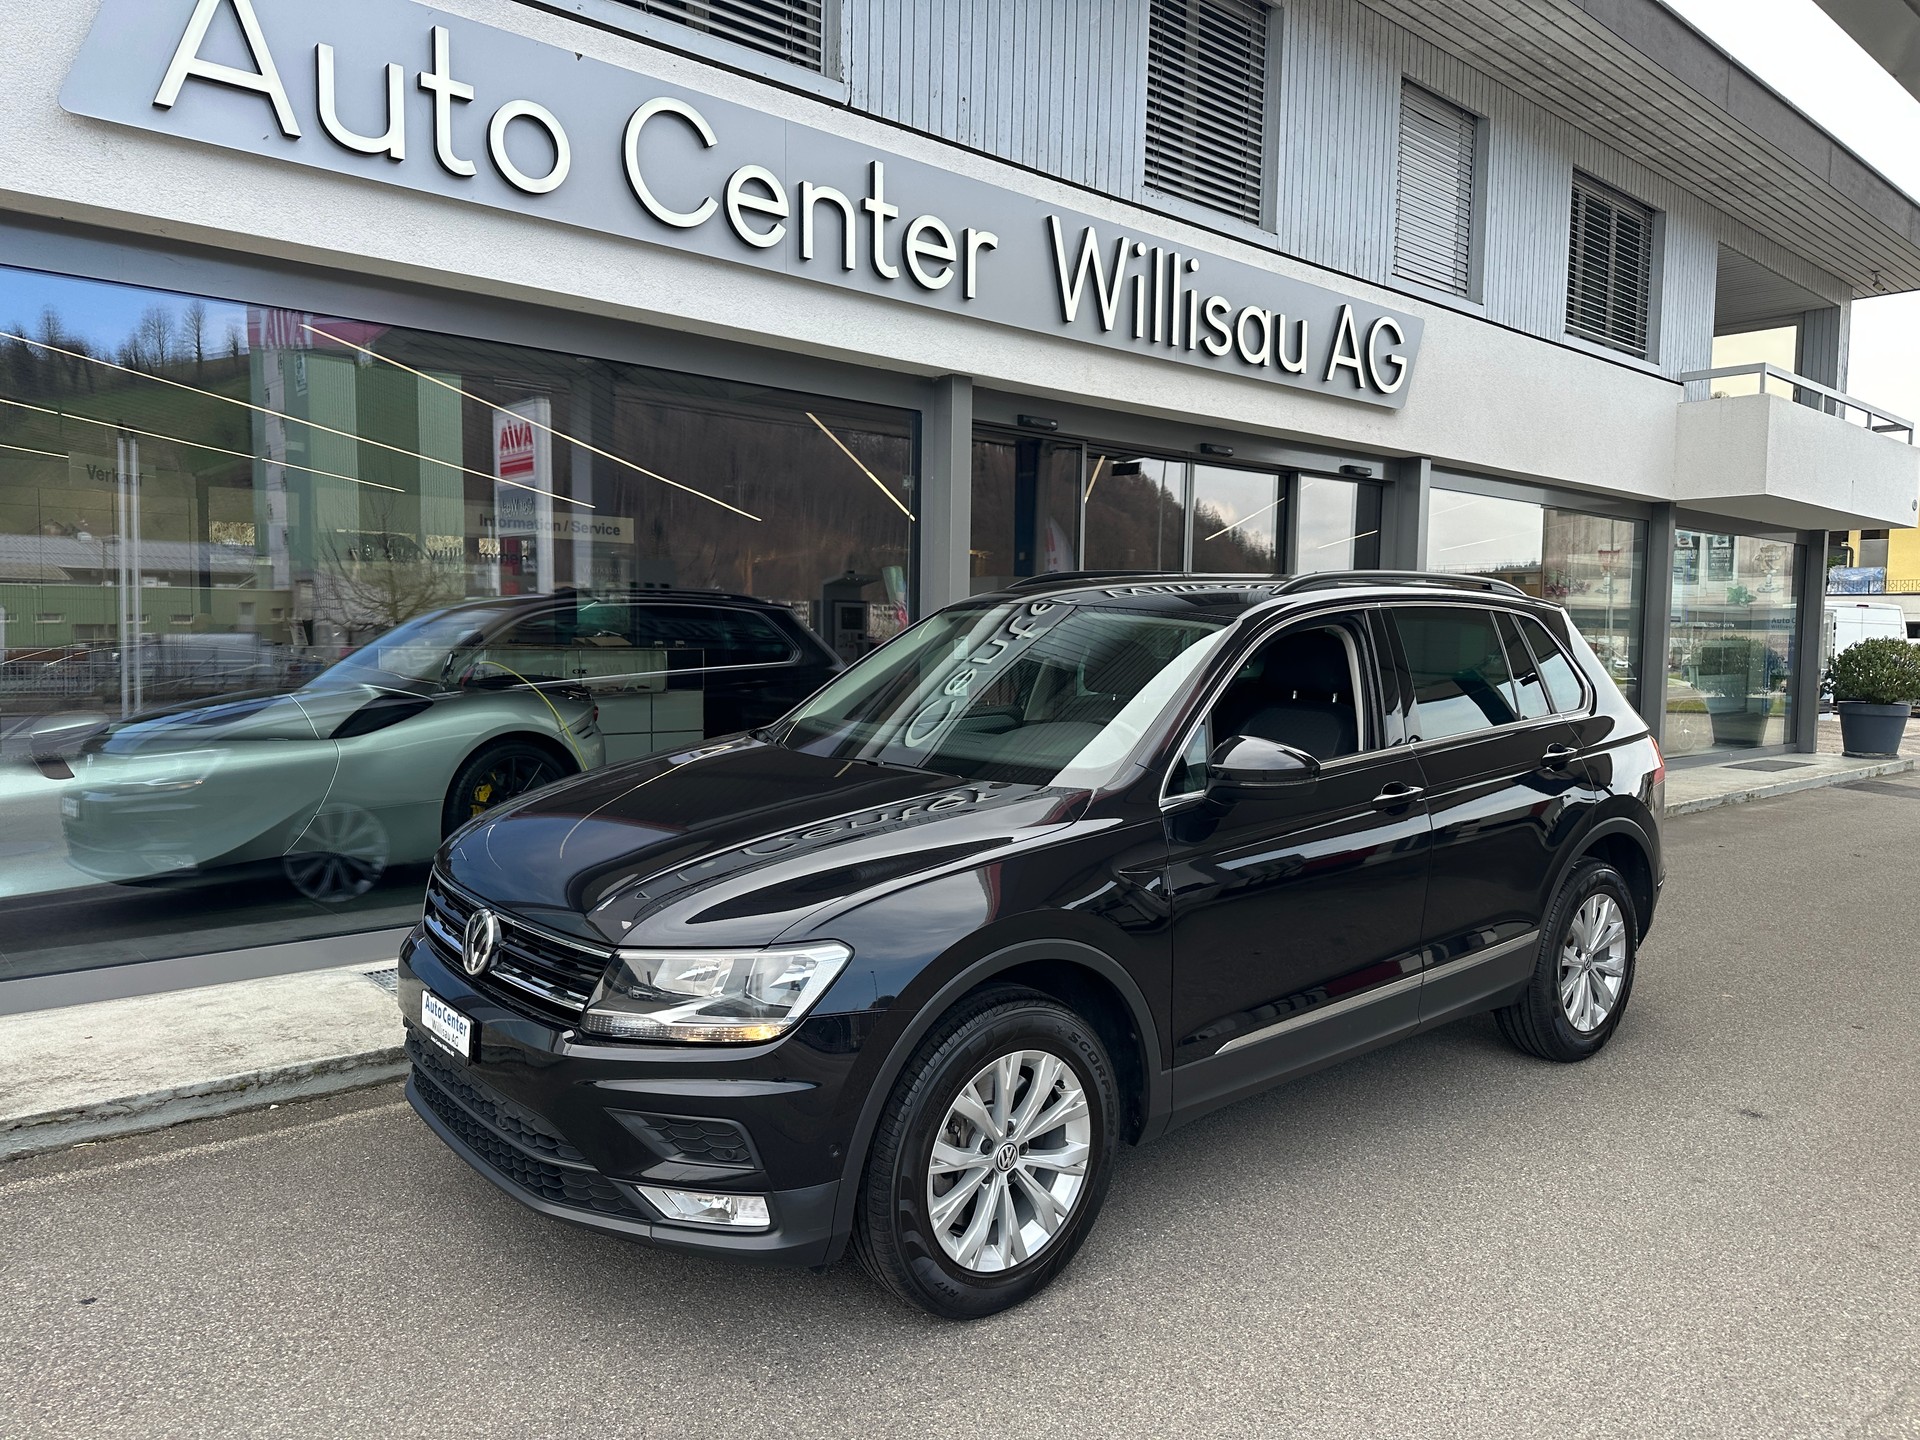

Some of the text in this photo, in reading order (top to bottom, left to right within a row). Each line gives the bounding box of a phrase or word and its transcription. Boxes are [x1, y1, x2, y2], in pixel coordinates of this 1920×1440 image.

[153, 0, 1408, 394] Auto Center Willisau AG
[480, 513, 560, 532] Information
[571, 520, 621, 536] Service
